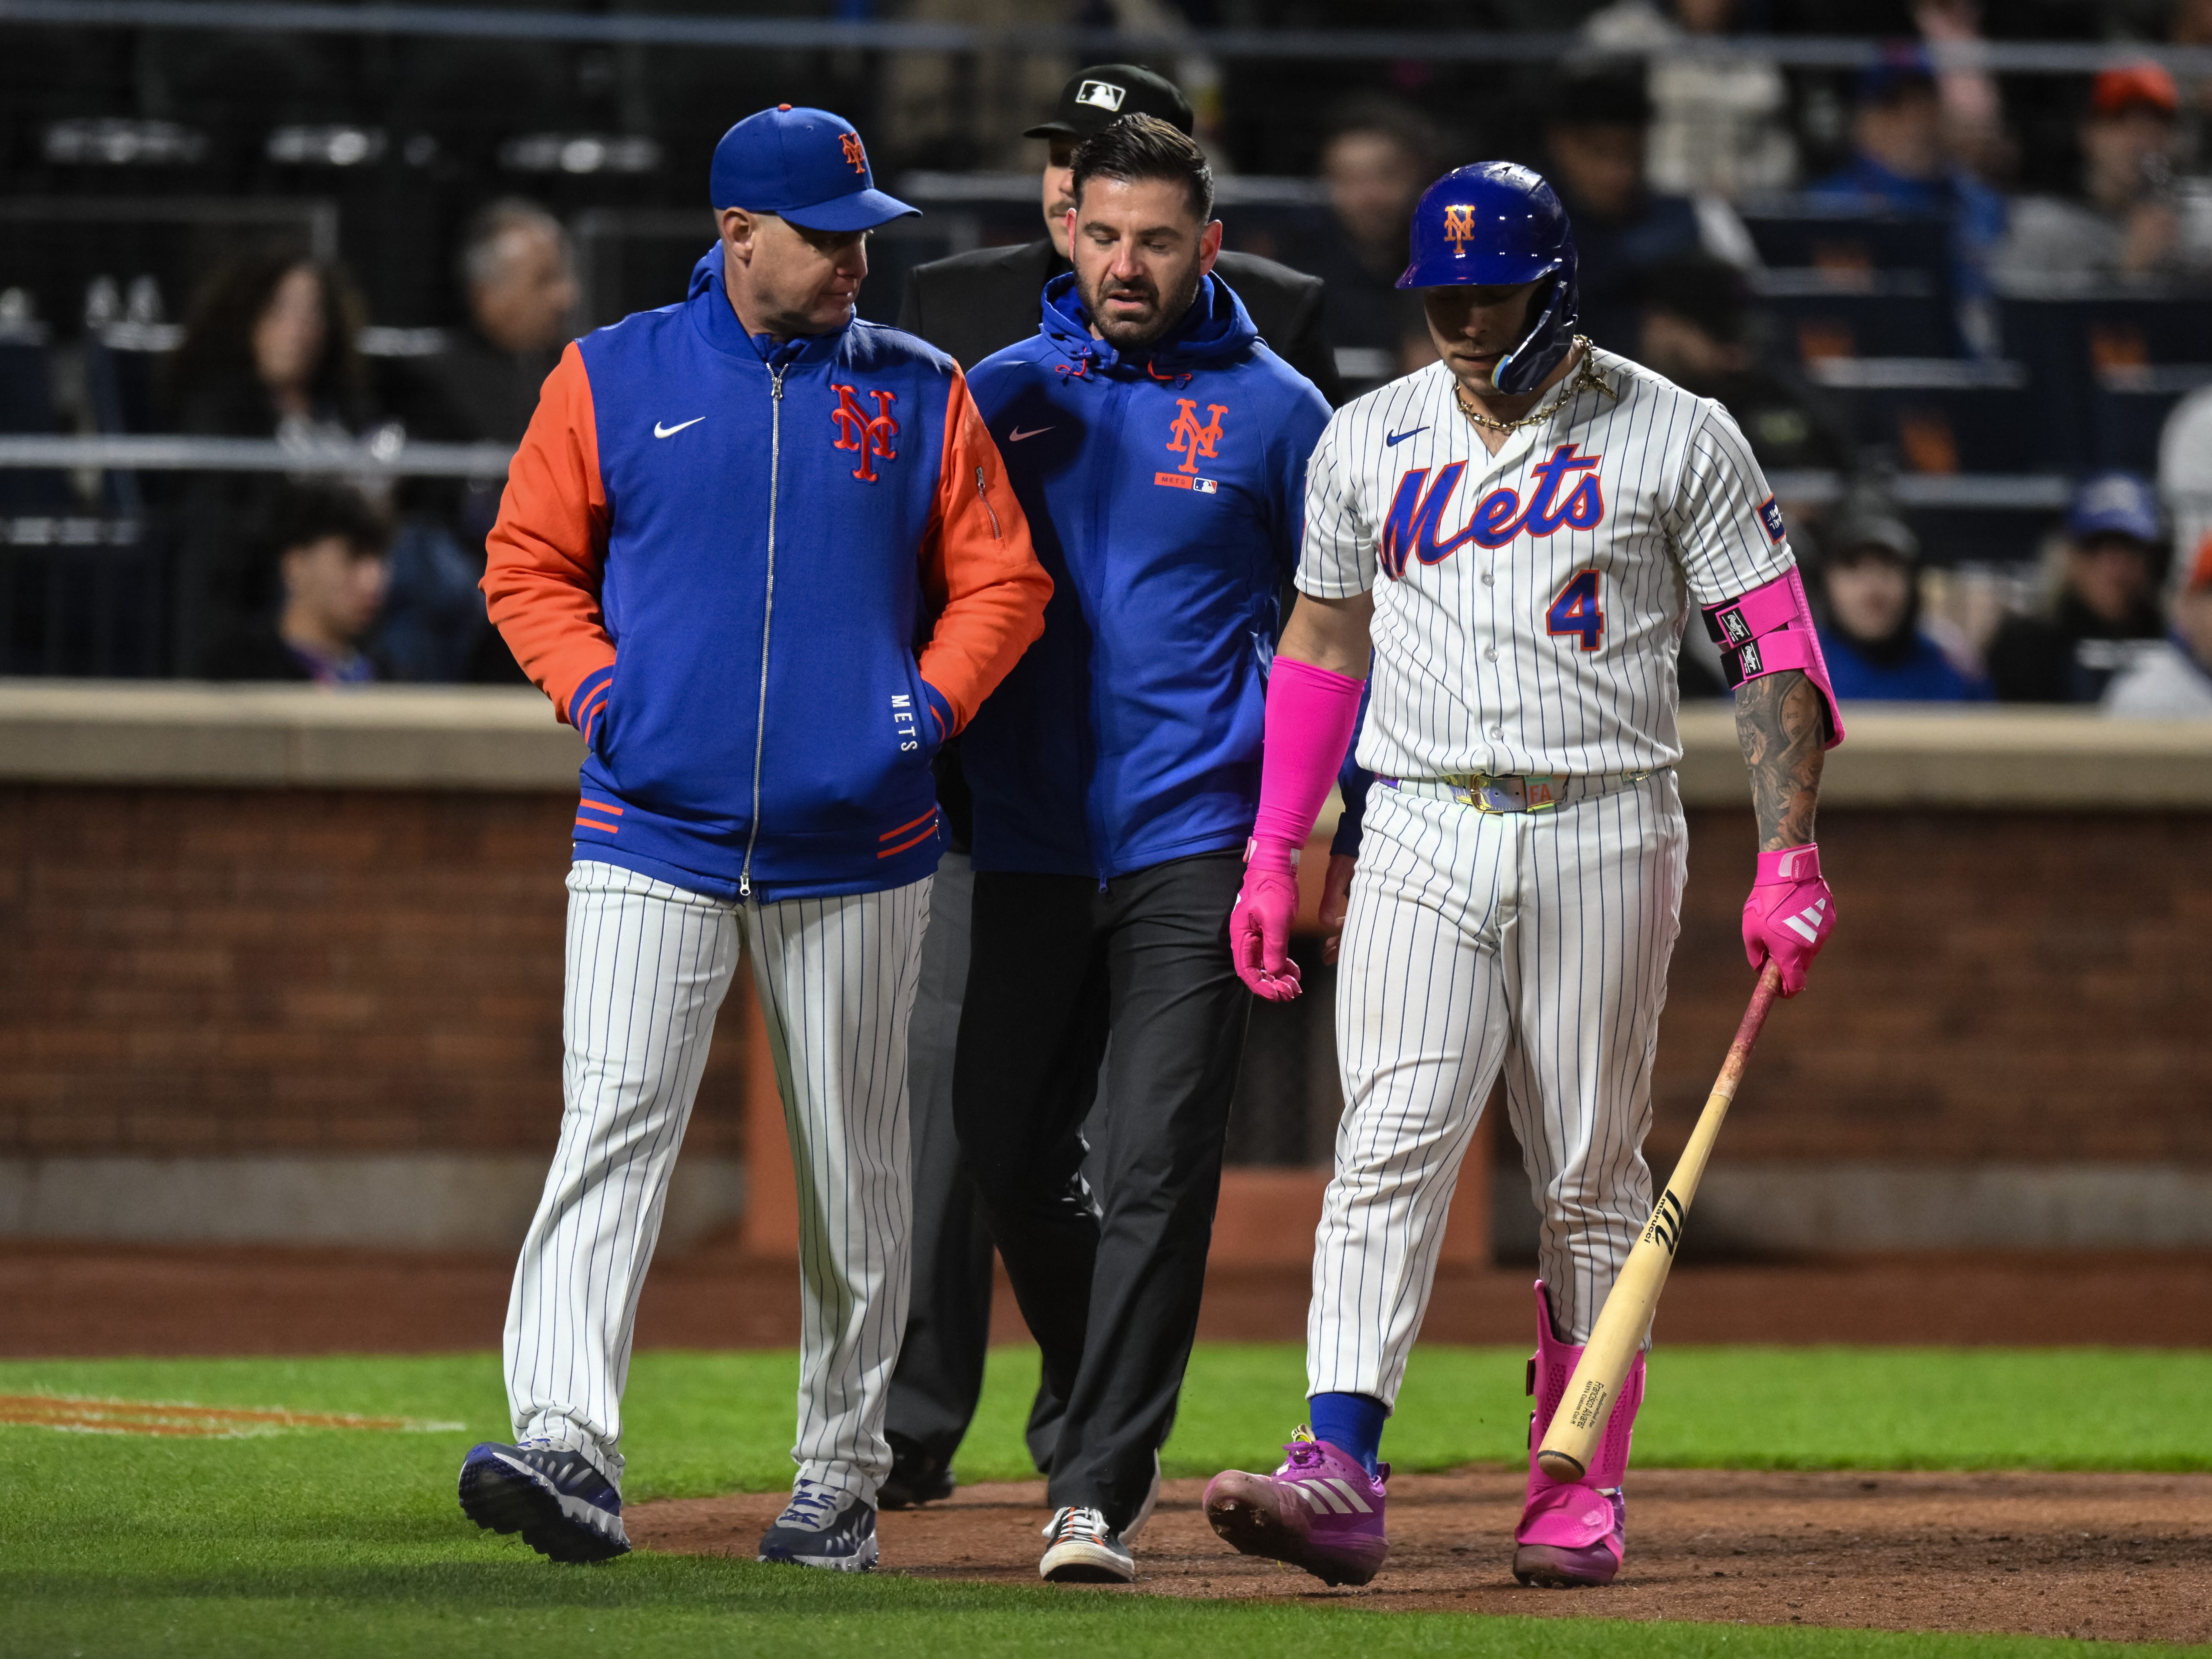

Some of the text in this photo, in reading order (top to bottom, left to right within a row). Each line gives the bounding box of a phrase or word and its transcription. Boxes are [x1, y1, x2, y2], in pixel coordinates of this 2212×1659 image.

[1161, 476, 1185, 485] METS
[1378, 443, 1605, 581] Mets
[1545, 569, 1604, 651] 4
[1728, 614, 1745, 637] Rawlings
[1745, 645, 1757, 670] Rawlings
[891, 694, 918, 751] METS
[1644, 1198, 1666, 1244] marucci
[1576, 1393, 1587, 1410] Custom
[1576, 1381, 1605, 1429] Francisco Alvarez
[1592, 1391, 1607, 1420] Handcrafted
